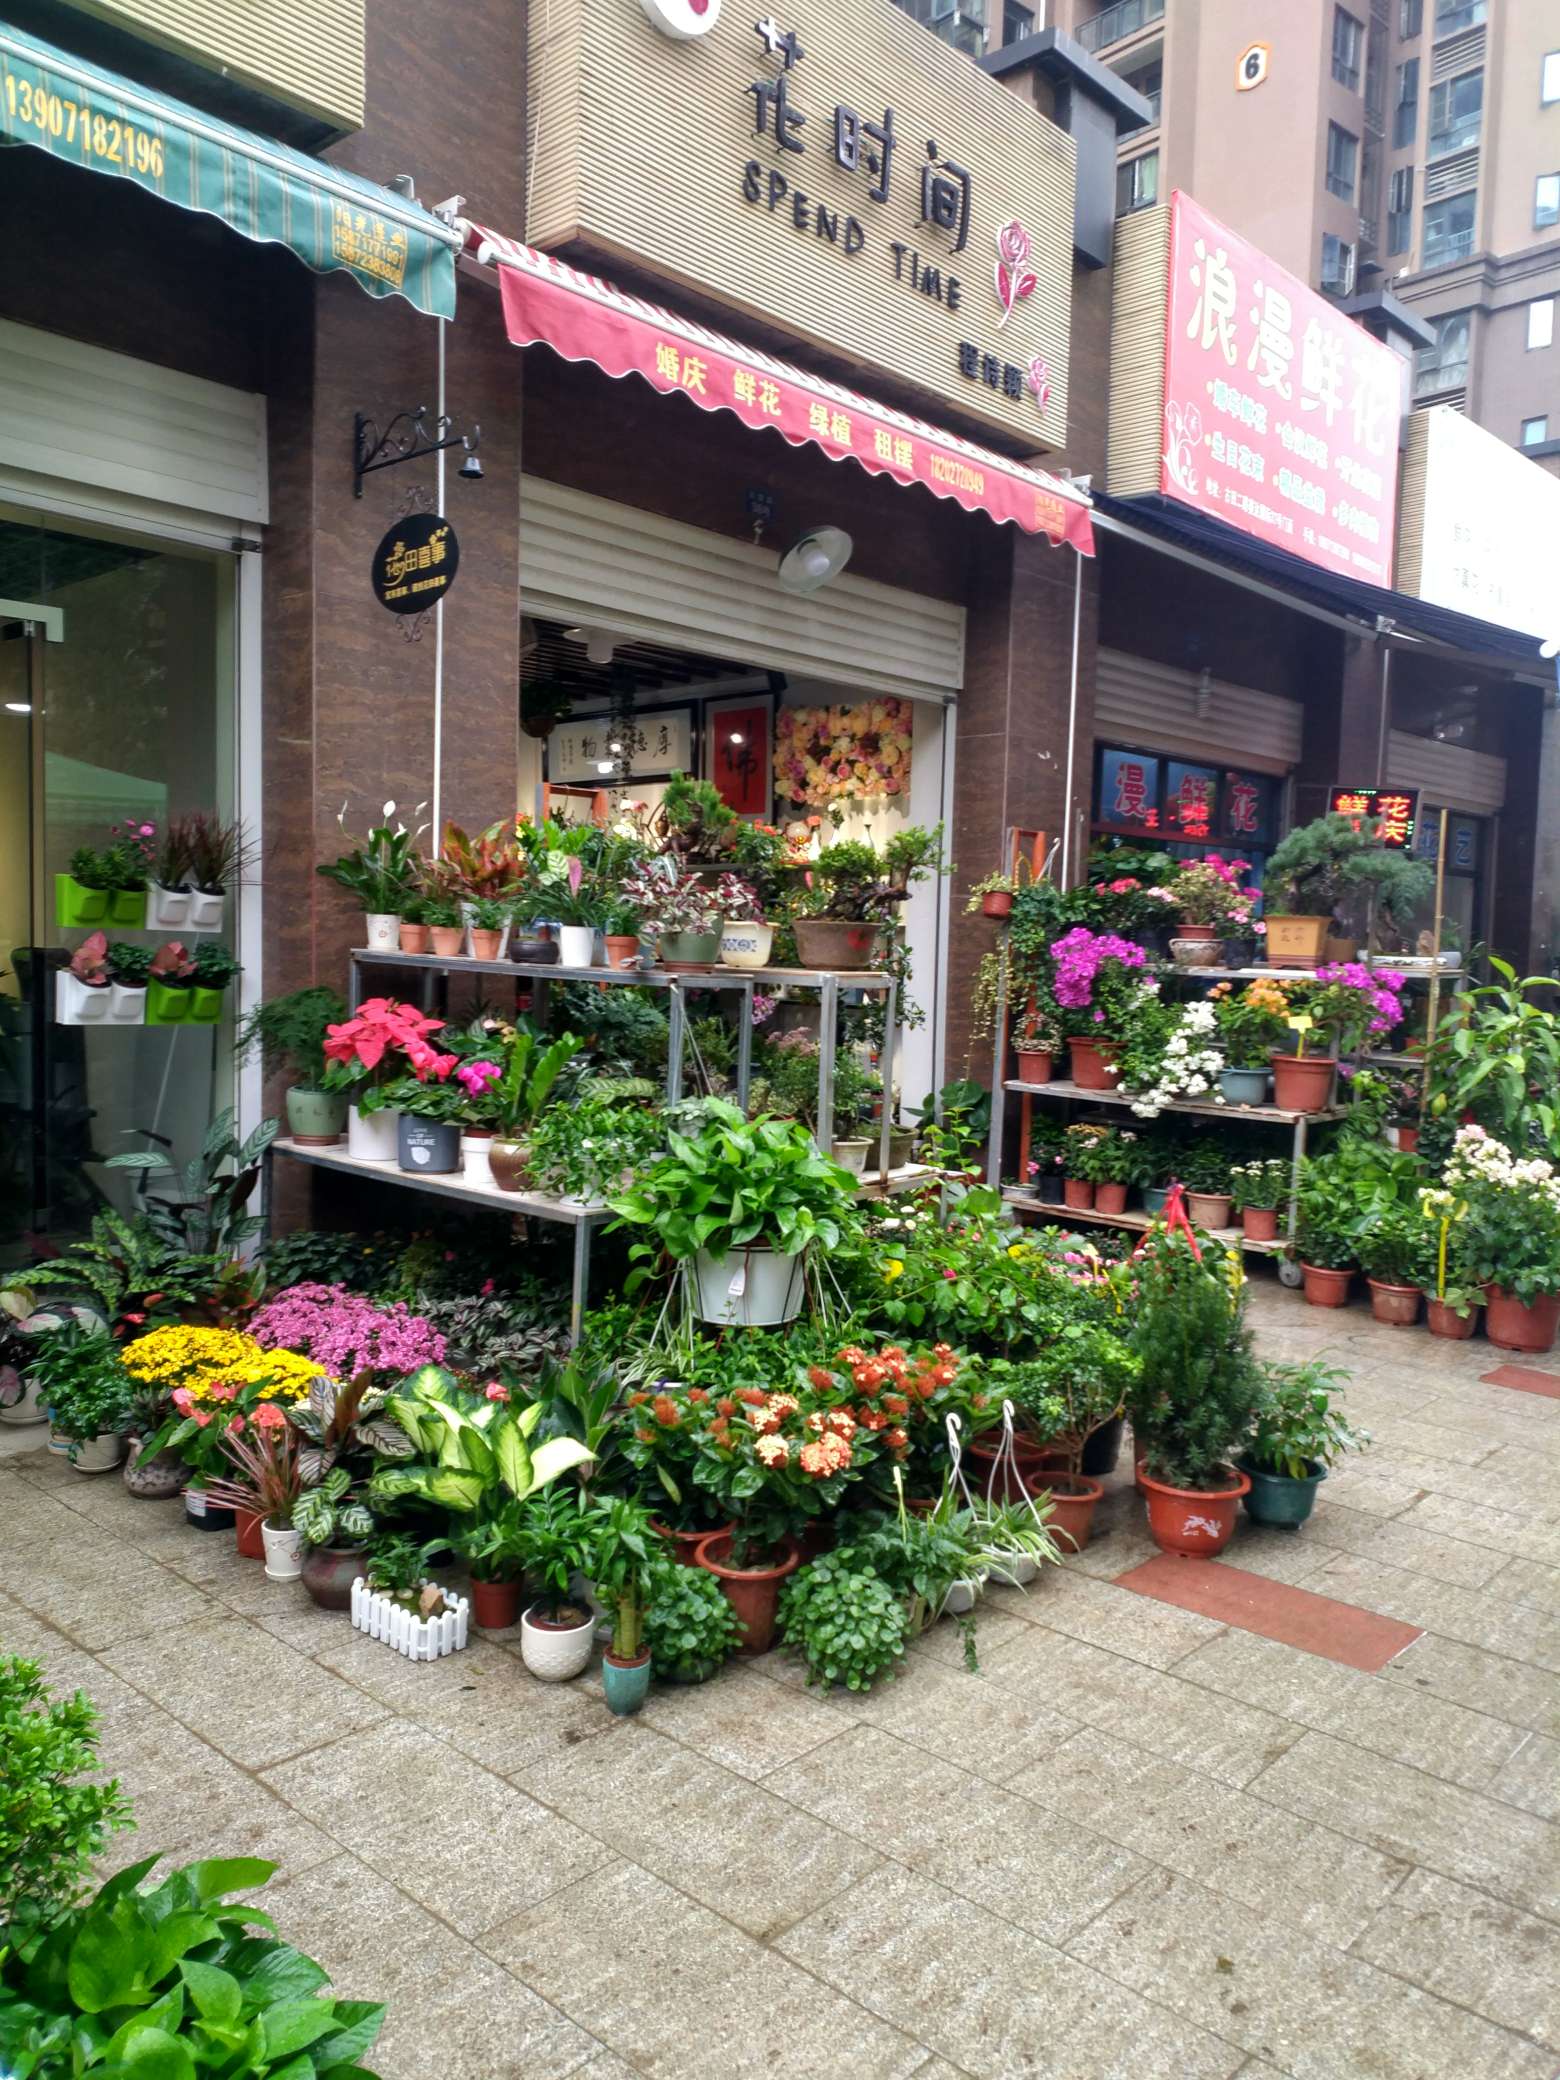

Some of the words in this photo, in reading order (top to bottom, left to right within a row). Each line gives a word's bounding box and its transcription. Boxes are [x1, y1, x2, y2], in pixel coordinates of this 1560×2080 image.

[1244, 54, 1260, 79] 6
[5, 75, 164, 178] 13907182196
[744, 16, 971, 253] 花时间
[743, 160, 865, 254] SPEND
[891, 241, 962, 310] TIME
[655, 342, 707, 395] 婚庆
[734, 369, 781, 416] 鲜花
[809, 403, 852, 447] 绿植
[874, 429, 913, 471] 租摆
[1336, 795, 1410, 817] 鲜花
